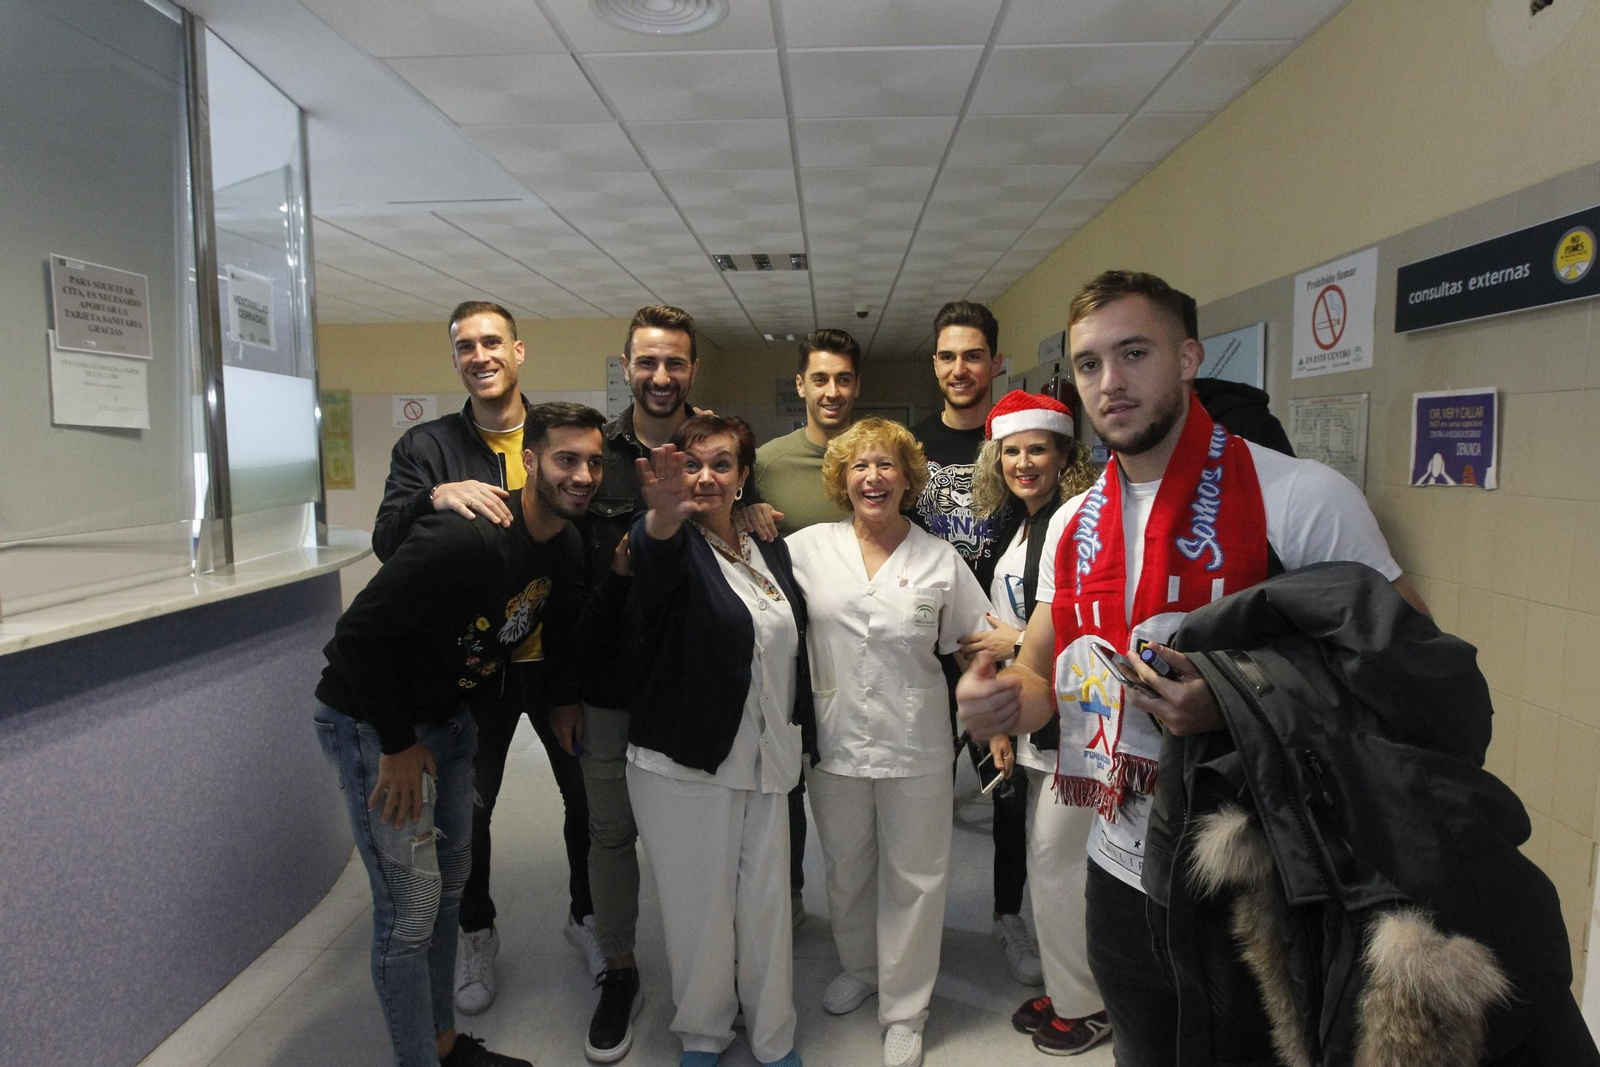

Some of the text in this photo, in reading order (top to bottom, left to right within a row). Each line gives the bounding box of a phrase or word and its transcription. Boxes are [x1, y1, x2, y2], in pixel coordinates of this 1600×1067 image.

[69, 275, 134, 296] PARA SOLICITAR
[1307, 267, 1357, 290] Prohibido fumar
[1408, 263, 1530, 304] consultas externas
[64, 309, 101, 322] TARJETA
[88, 324, 123, 336] GRACIAS
[1327, 349, 1351, 361] CENTRO
[1461, 406, 1484, 418] CALLAR
[1175, 465, 1224, 571] Somos
